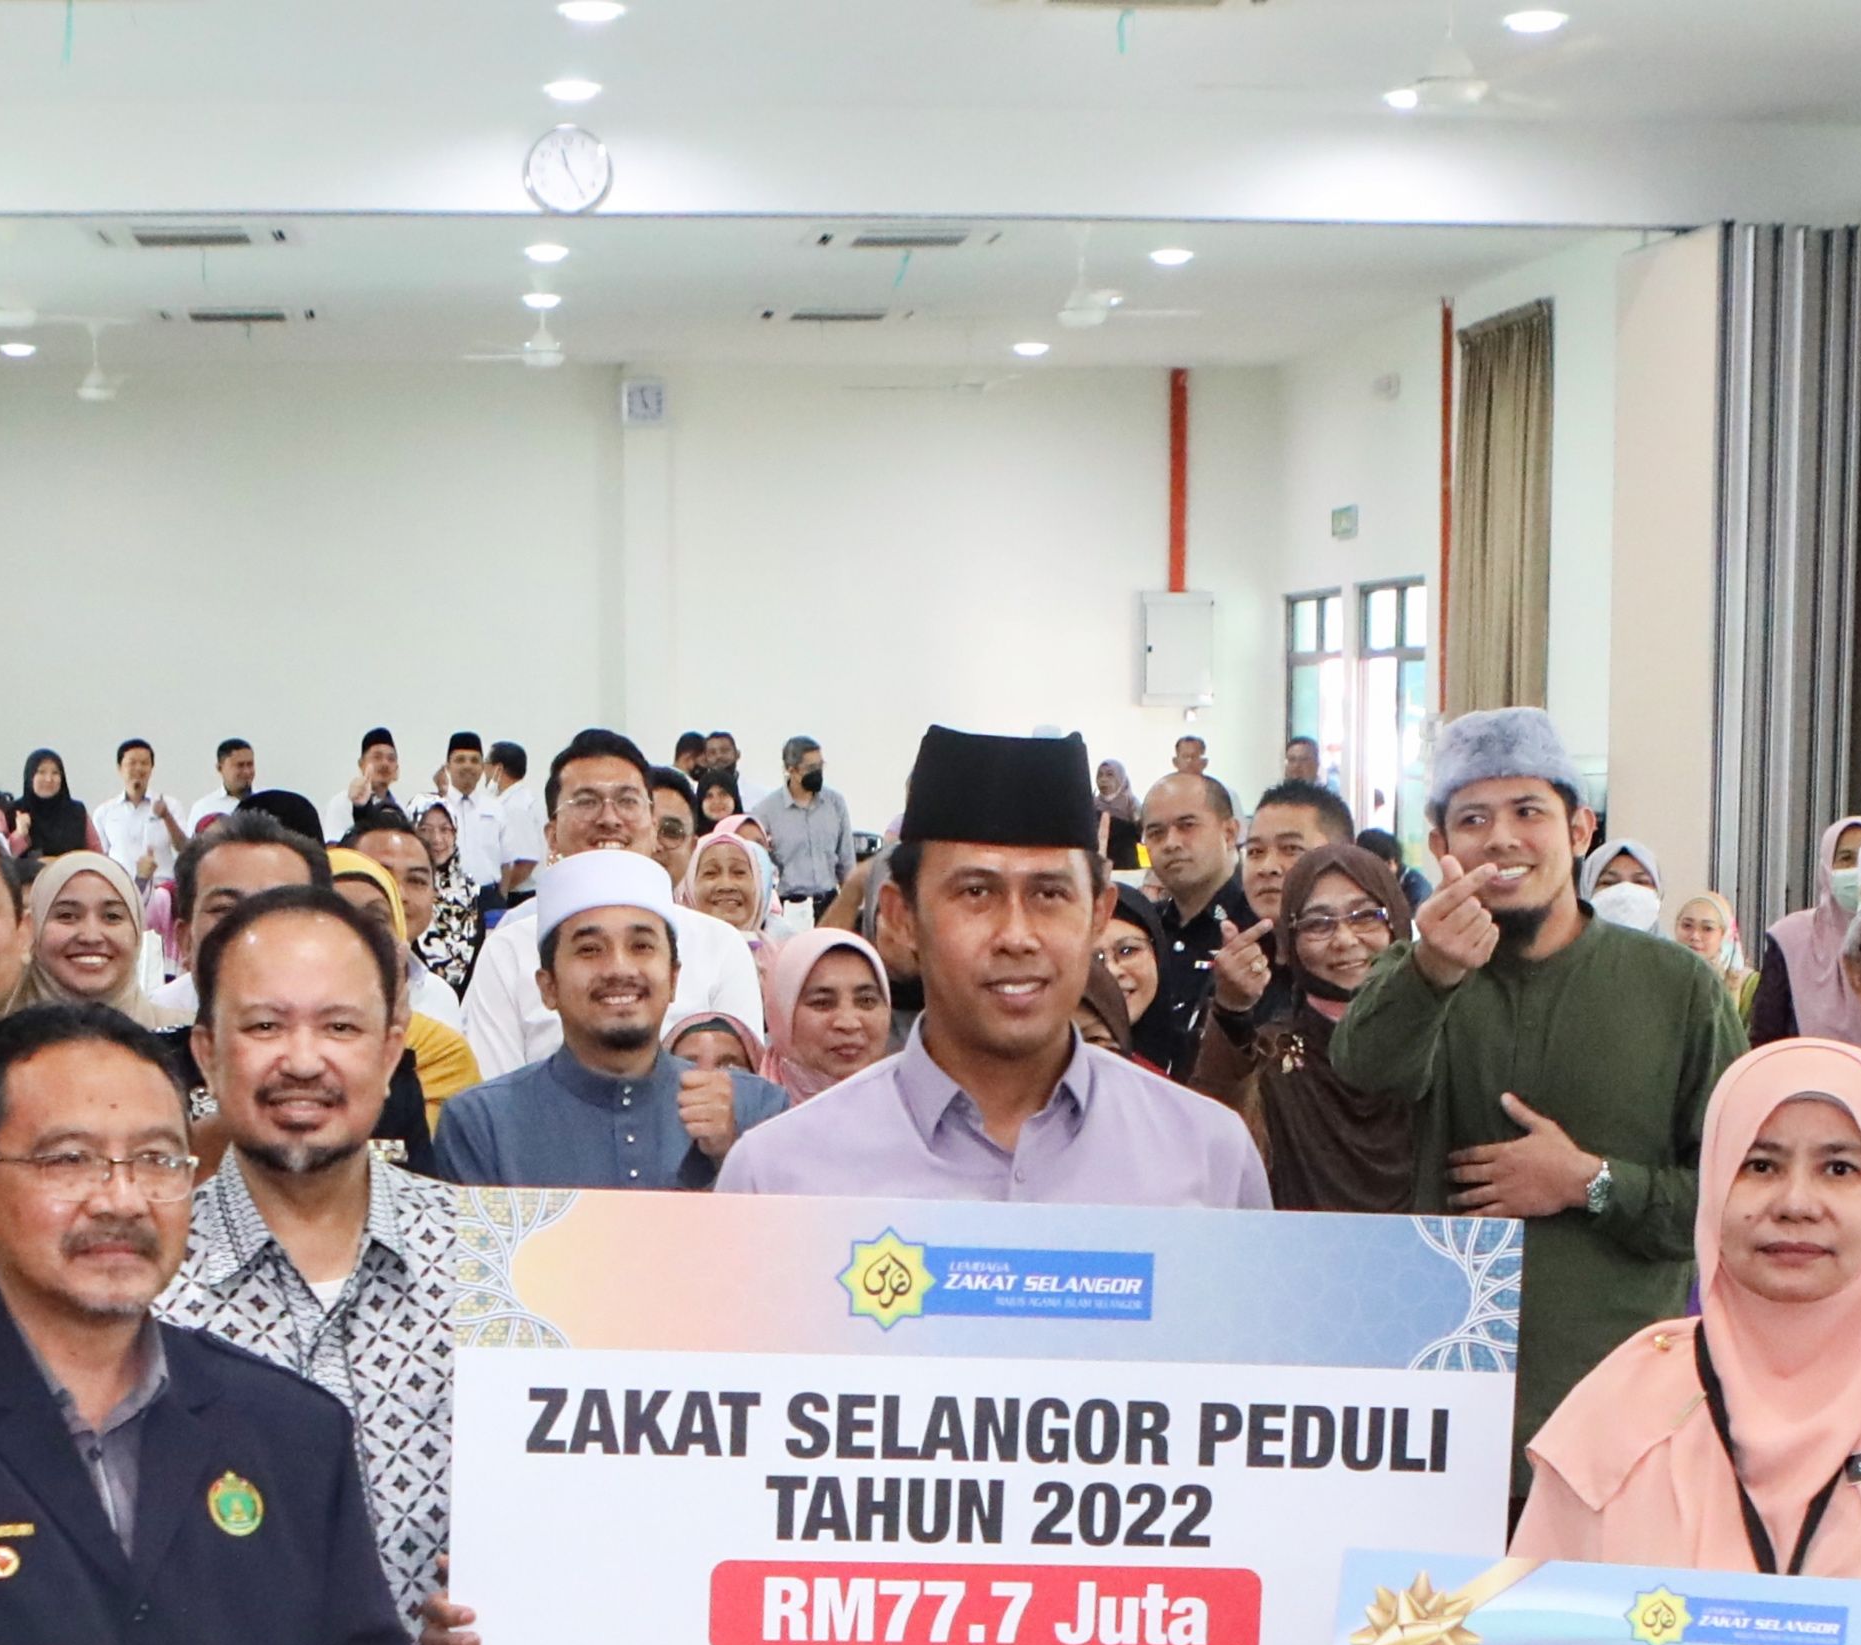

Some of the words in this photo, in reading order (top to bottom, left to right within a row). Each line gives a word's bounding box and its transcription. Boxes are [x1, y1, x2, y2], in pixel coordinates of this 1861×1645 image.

[944, 1273, 1019, 1291] ZAKAT
[1023, 1275, 1143, 1294] SELANGOR
[527, 1388, 760, 1456] ZAKAT
[786, 1393, 1169, 1464] SELANGOR
[1199, 1403, 1448, 1472] PEDULI
[767, 1476, 1003, 1543] TAHUN
[1032, 1482, 1211, 1547] 2022
[763, 1576, 1033, 1644] RM77.7
[1055, 1581, 1208, 1645] Juta
[1697, 1614, 1752, 1630] ZAKAT
[1754, 1617, 1841, 1636] SELANGOR
